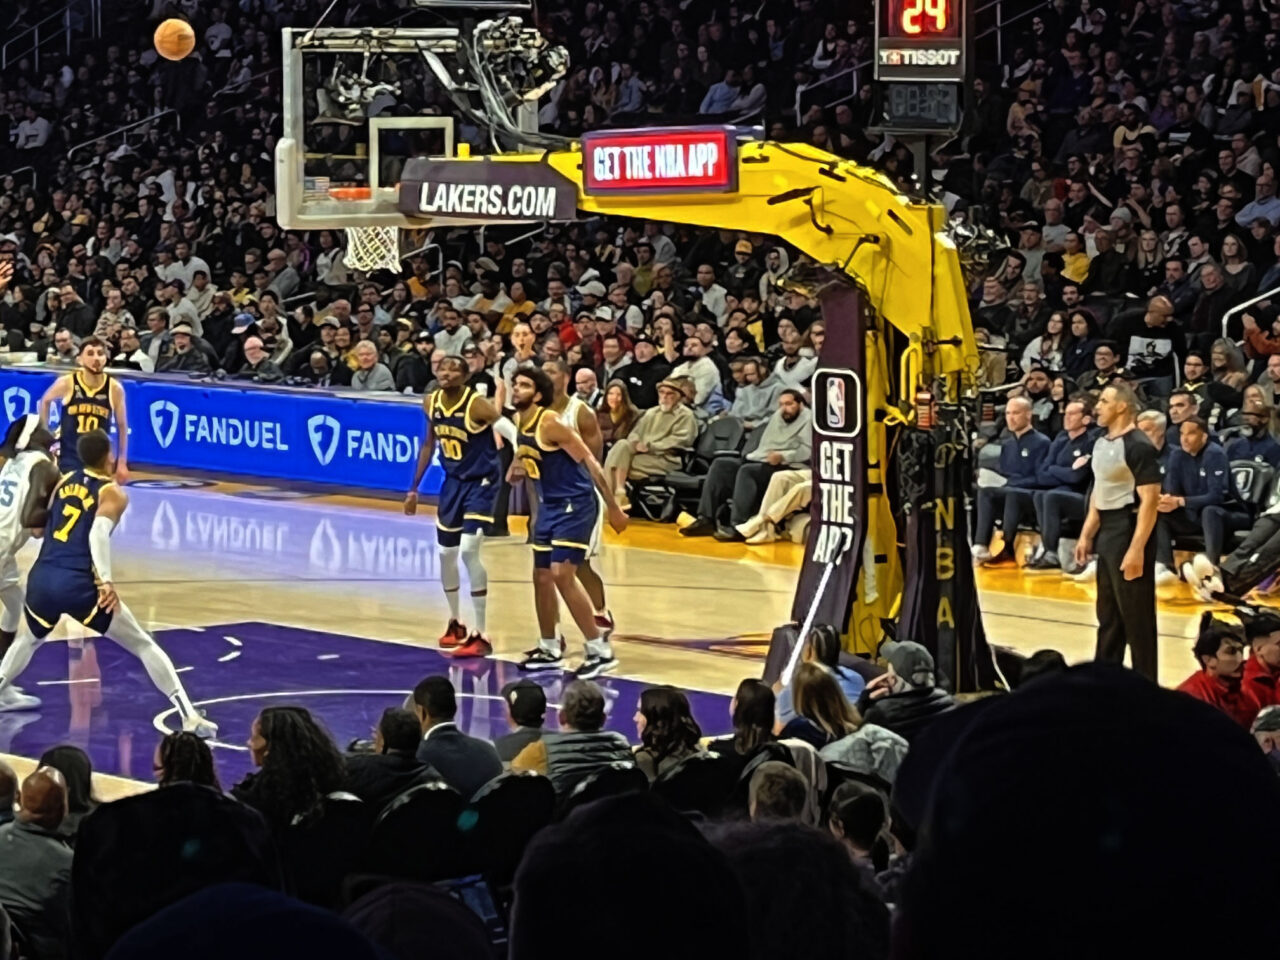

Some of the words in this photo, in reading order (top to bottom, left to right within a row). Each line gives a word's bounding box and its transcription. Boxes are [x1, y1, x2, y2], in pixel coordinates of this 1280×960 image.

[901, 49, 961, 66] TISSOT
[593, 146, 623, 181] GET
[623, 144, 653, 180] THE
[654, 143, 686, 178] NBA
[687, 142, 719, 178] APP
[418, 182, 557, 217] LAKERS.COM
[76, 415, 99, 434] 10
[185, 415, 289, 451] FANDUEL
[439, 437, 463, 461] 00
[819, 440, 854, 482] GET
[818, 482, 854, 524] THE
[53, 503, 82, 543] 7
